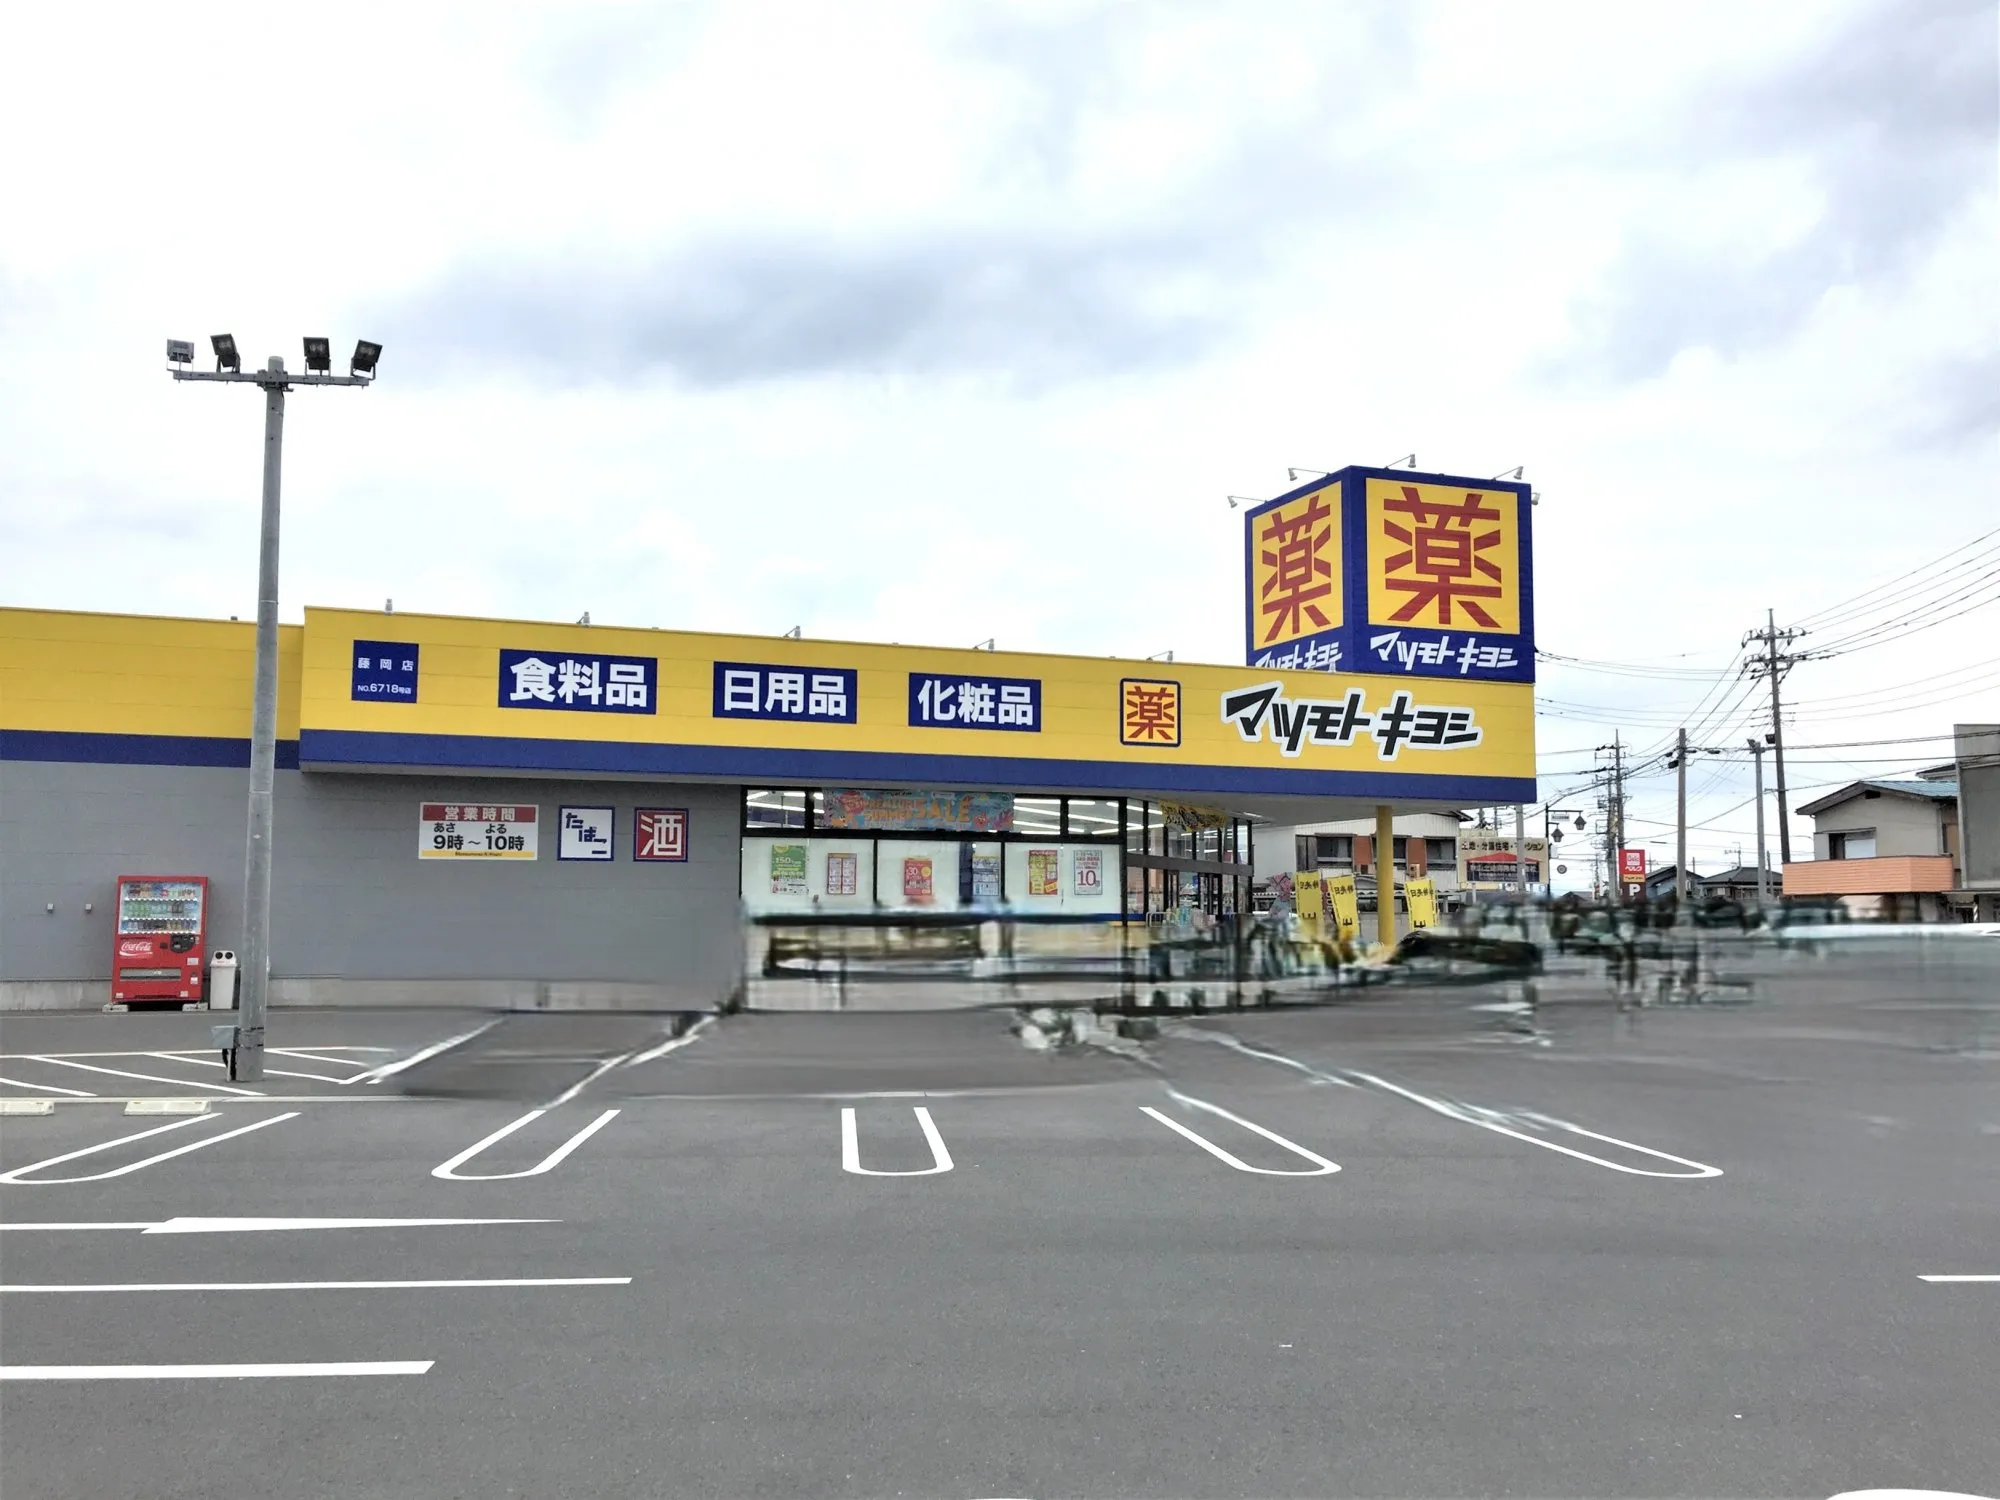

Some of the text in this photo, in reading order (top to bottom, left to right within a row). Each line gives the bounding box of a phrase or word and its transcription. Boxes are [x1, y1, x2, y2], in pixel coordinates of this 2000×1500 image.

[1262, 495, 1331, 643] 薬
[1384, 486, 1502, 628] 薬
[358, 657, 414, 671] 藤岡店
[1370, 631, 1518, 673] マツモトキヨシ
[510, 658, 647, 707] 食料品
[724, 670, 847, 716] 日用品
[918, 679, 1033, 726] 化粧品
[1127, 686, 1174, 740] 薬
[1224, 685, 1480, 758] マツモトキヨシ
[434, 823, 507, 834] あさ よる
[445, 807, 515, 821] 営業時間
[915, 798, 970, 822] SALE
[566, 812, 607, 854] たばこ
[641, 814, 682, 855] 酒
[1077, 870, 1097, 886] 10
[1629, 884, 1640, 896] P
